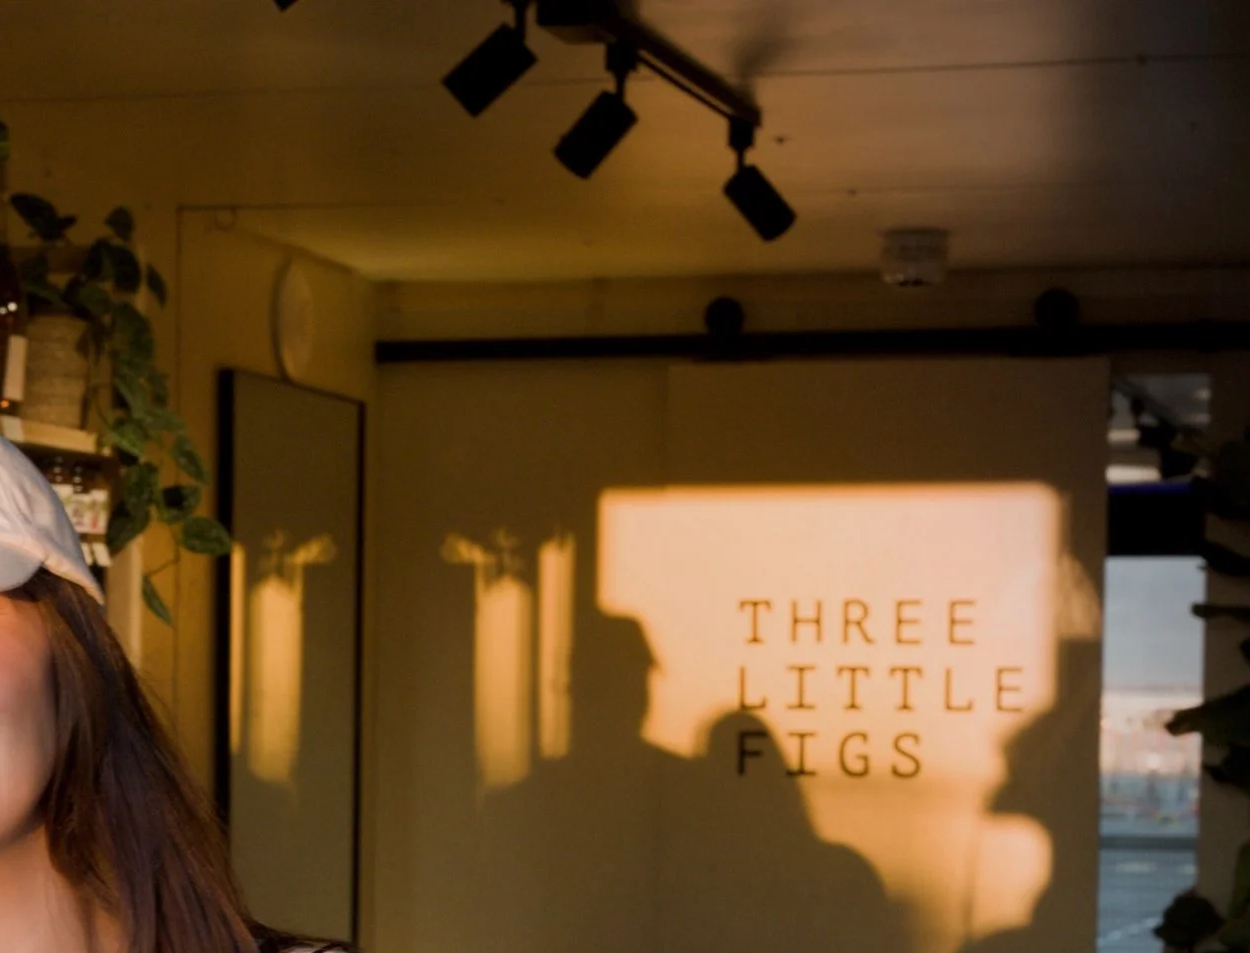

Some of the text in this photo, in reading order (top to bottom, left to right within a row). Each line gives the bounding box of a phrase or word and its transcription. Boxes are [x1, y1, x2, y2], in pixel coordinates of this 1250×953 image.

[738, 598, 976, 645] THREE
[738, 666, 1025, 712] LITTLE
[736, 731, 922, 778] FIGS
